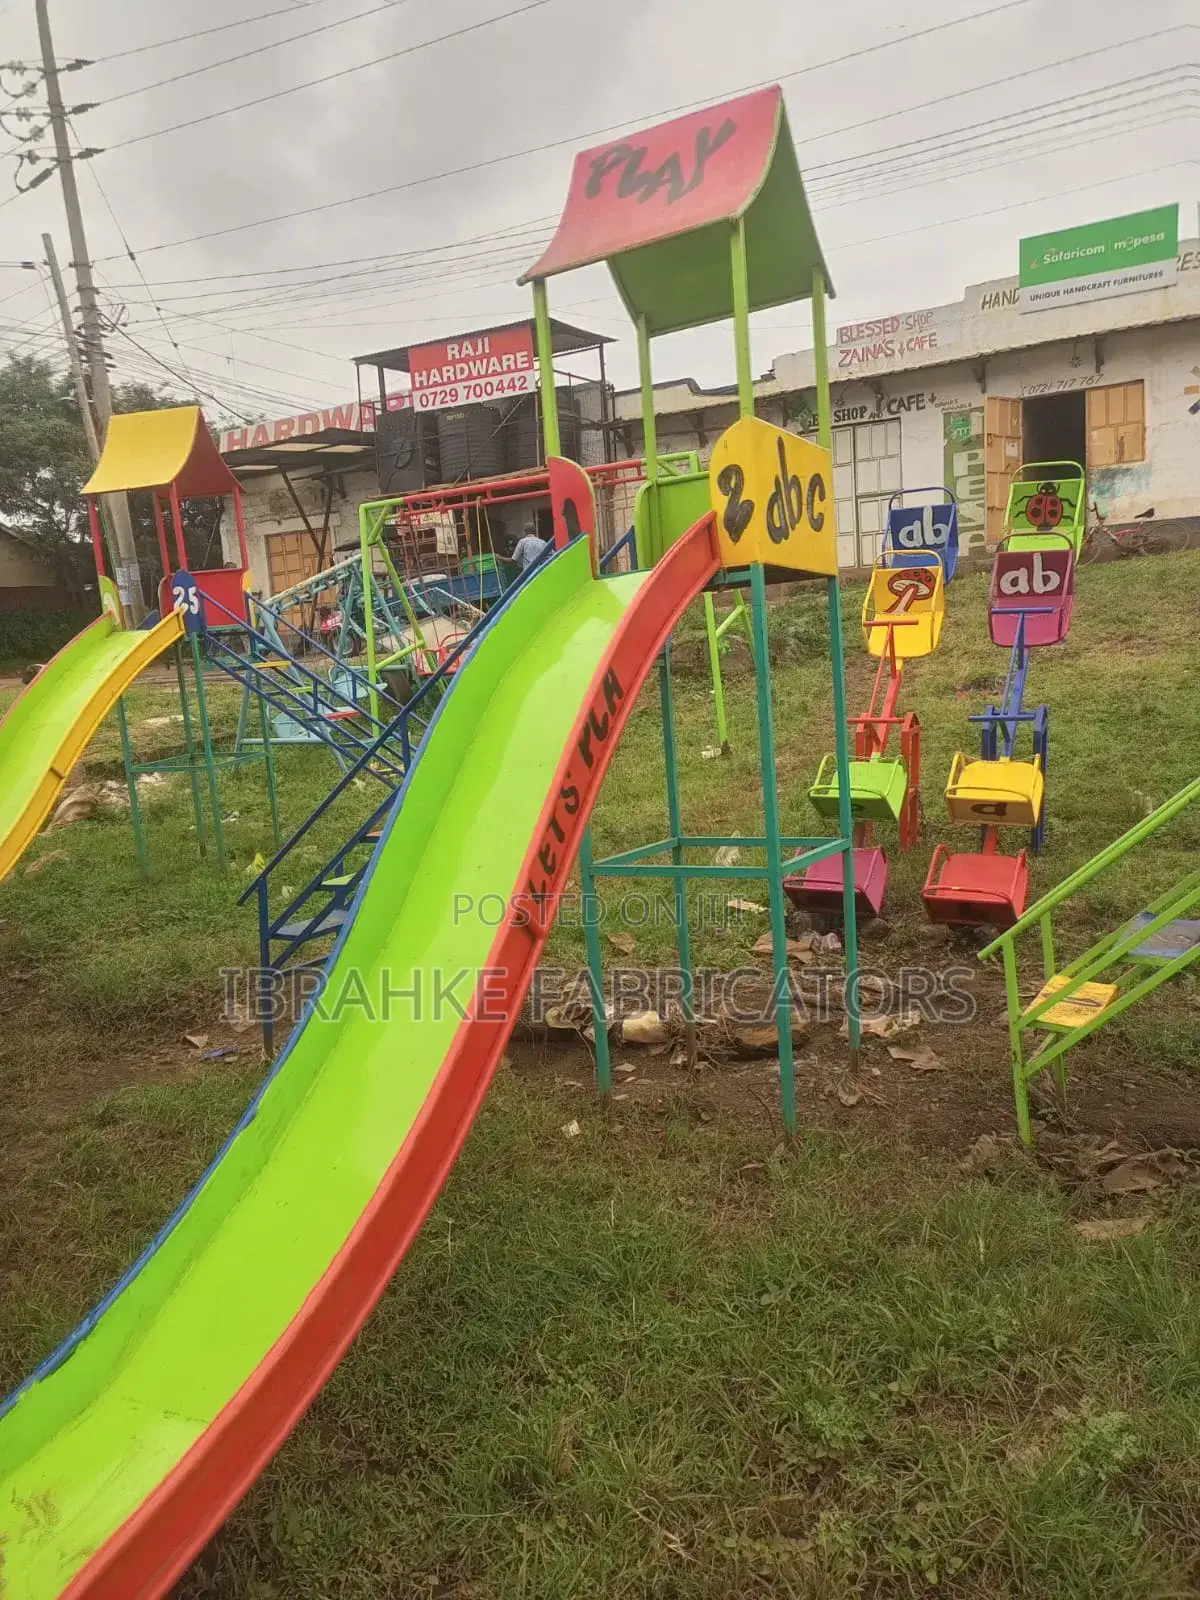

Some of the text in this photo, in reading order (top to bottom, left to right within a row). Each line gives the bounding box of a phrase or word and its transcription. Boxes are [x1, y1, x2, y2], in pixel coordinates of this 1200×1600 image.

[584, 117, 737, 206] PLAY
[1043, 244, 1105, 265] Safaricom
[1029, 270, 1163, 302] UNIQUE HANDCRAFT FURNITURES
[839, 311, 933, 344] BLESSED SHOP
[906, 332, 937, 352] CAFE
[447, 336, 490, 360] RAJI
[414, 350, 529, 388] HARDWARE
[420, 375, 528, 408] 0729 700442
[833, 405, 868, 423] SHOP
[887, 393, 926, 415] CAFE
[717, 463, 755, 546] 2
[899, 506, 949, 547] ab
[1000, 552, 1060, 594] ab
[172, 586, 199, 615] 25
